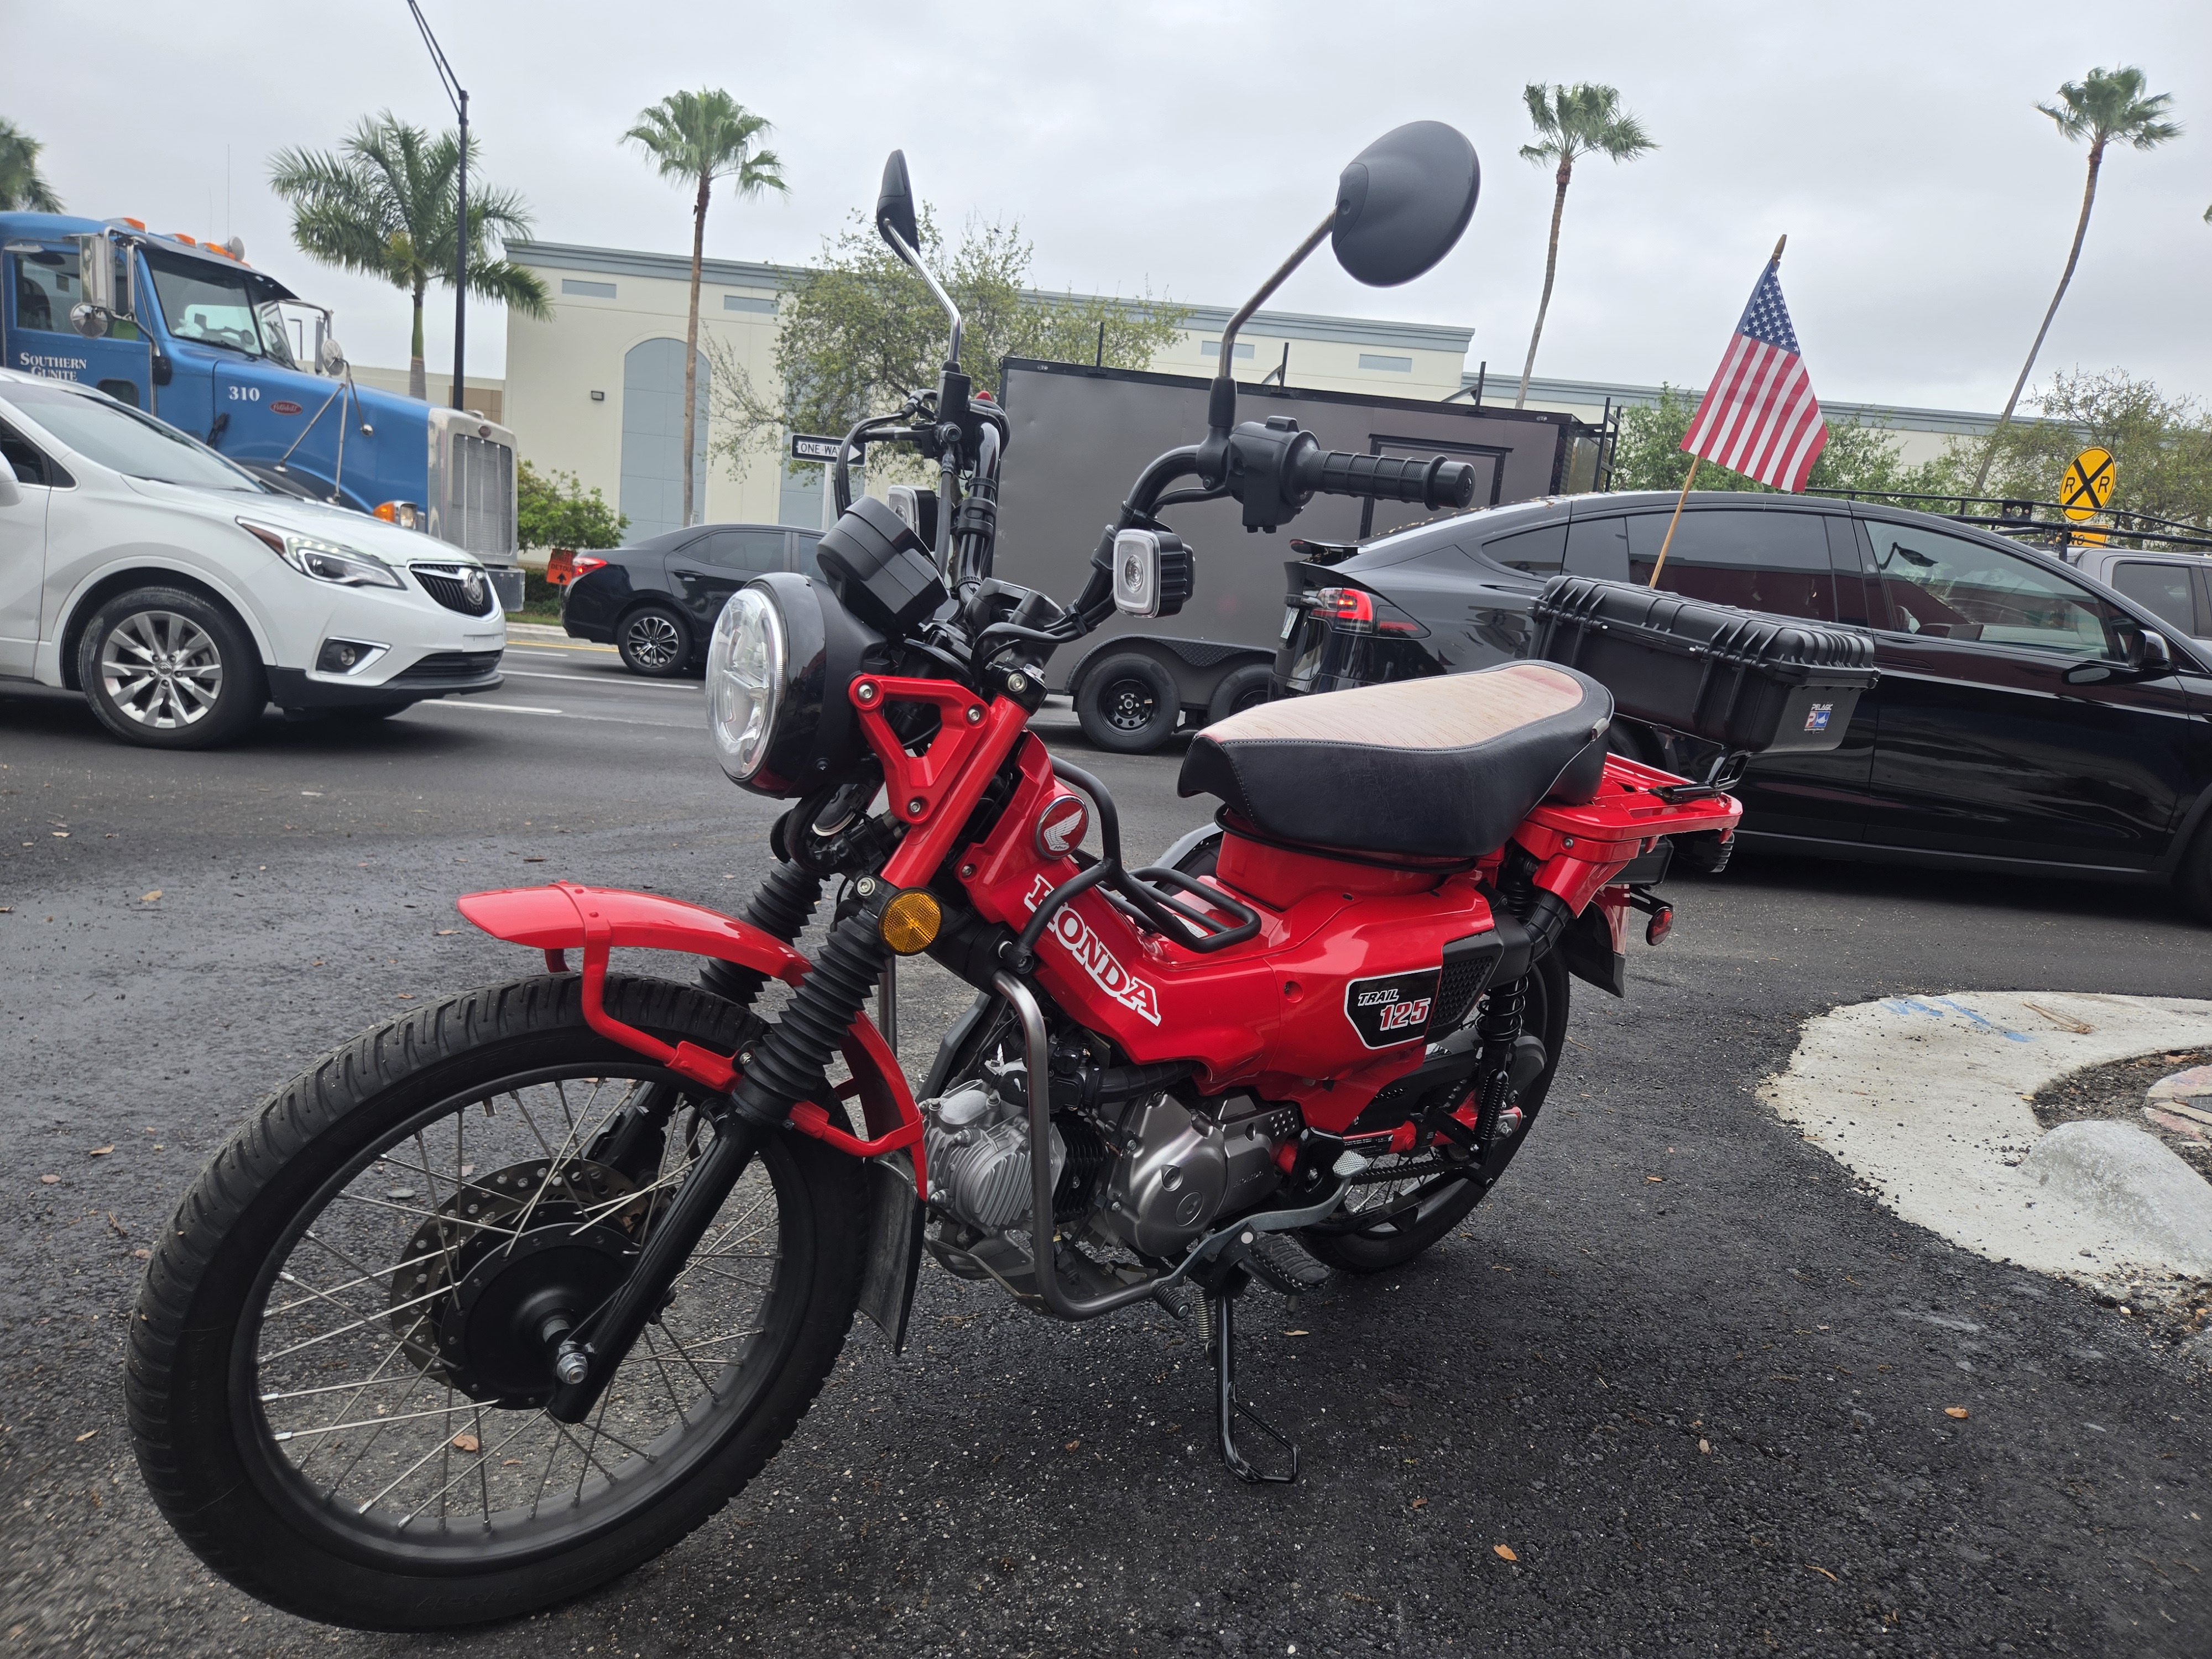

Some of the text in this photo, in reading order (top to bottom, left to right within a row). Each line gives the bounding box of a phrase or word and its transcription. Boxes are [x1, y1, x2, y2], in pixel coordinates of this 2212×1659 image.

[20, 352, 87, 370] SOUTHERN
[31, 366, 77, 382] GUNITE
[228, 386, 260, 401] 310
[801, 443, 821, 454] ONE
[551, 564, 572, 572] DETOU
[1358, 989, 1400, 1006] TRAIL
[1380, 998, 1431, 1031] 125
